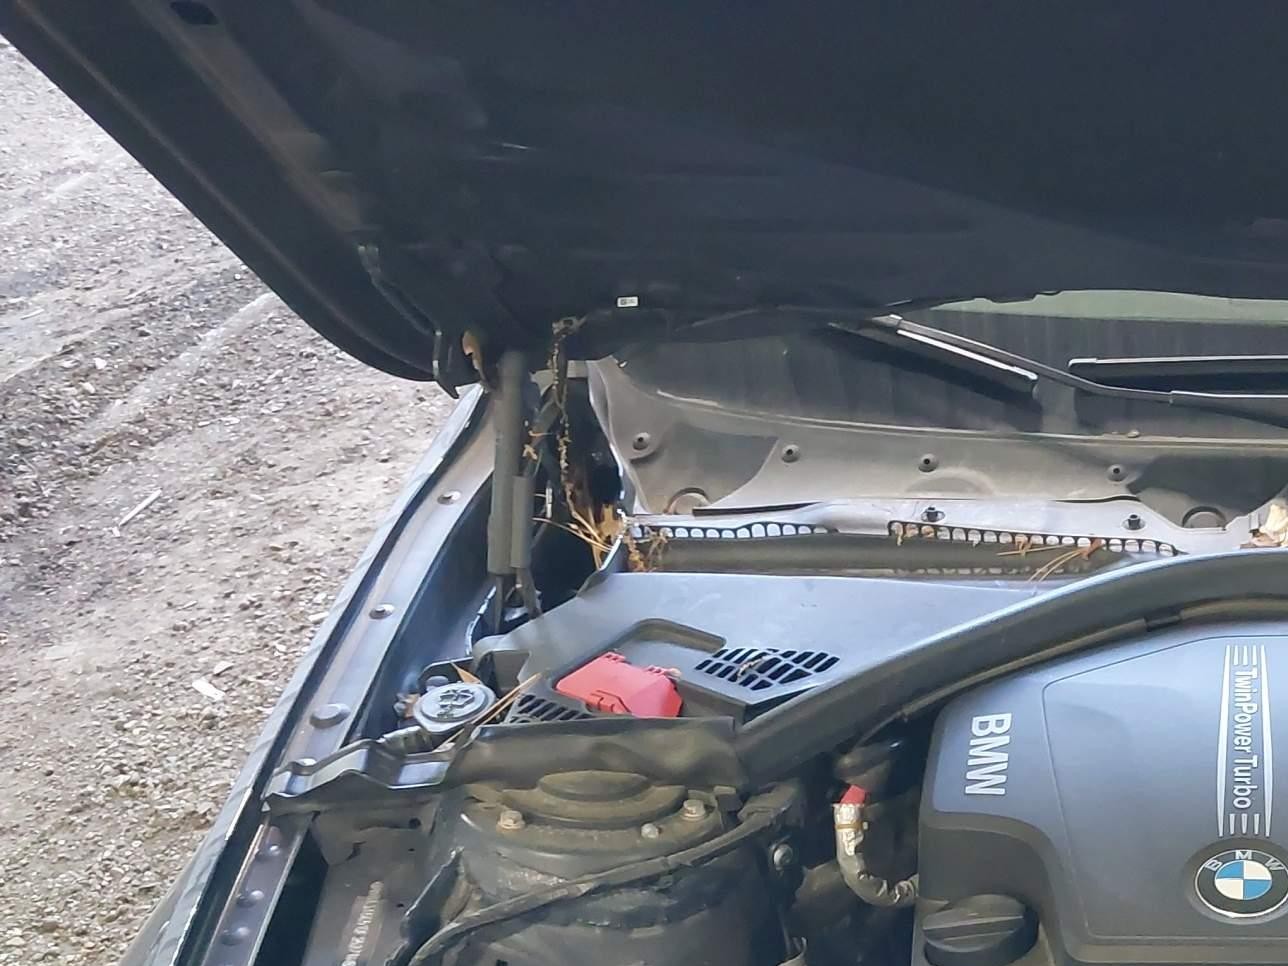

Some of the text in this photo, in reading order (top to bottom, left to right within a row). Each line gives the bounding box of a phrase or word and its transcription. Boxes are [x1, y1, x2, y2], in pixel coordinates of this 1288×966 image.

[965, 713, 1012, 795] BMW
[1232, 667, 1259, 810] TwinPower Turbo
[1204, 849, 1285, 872] BMW
